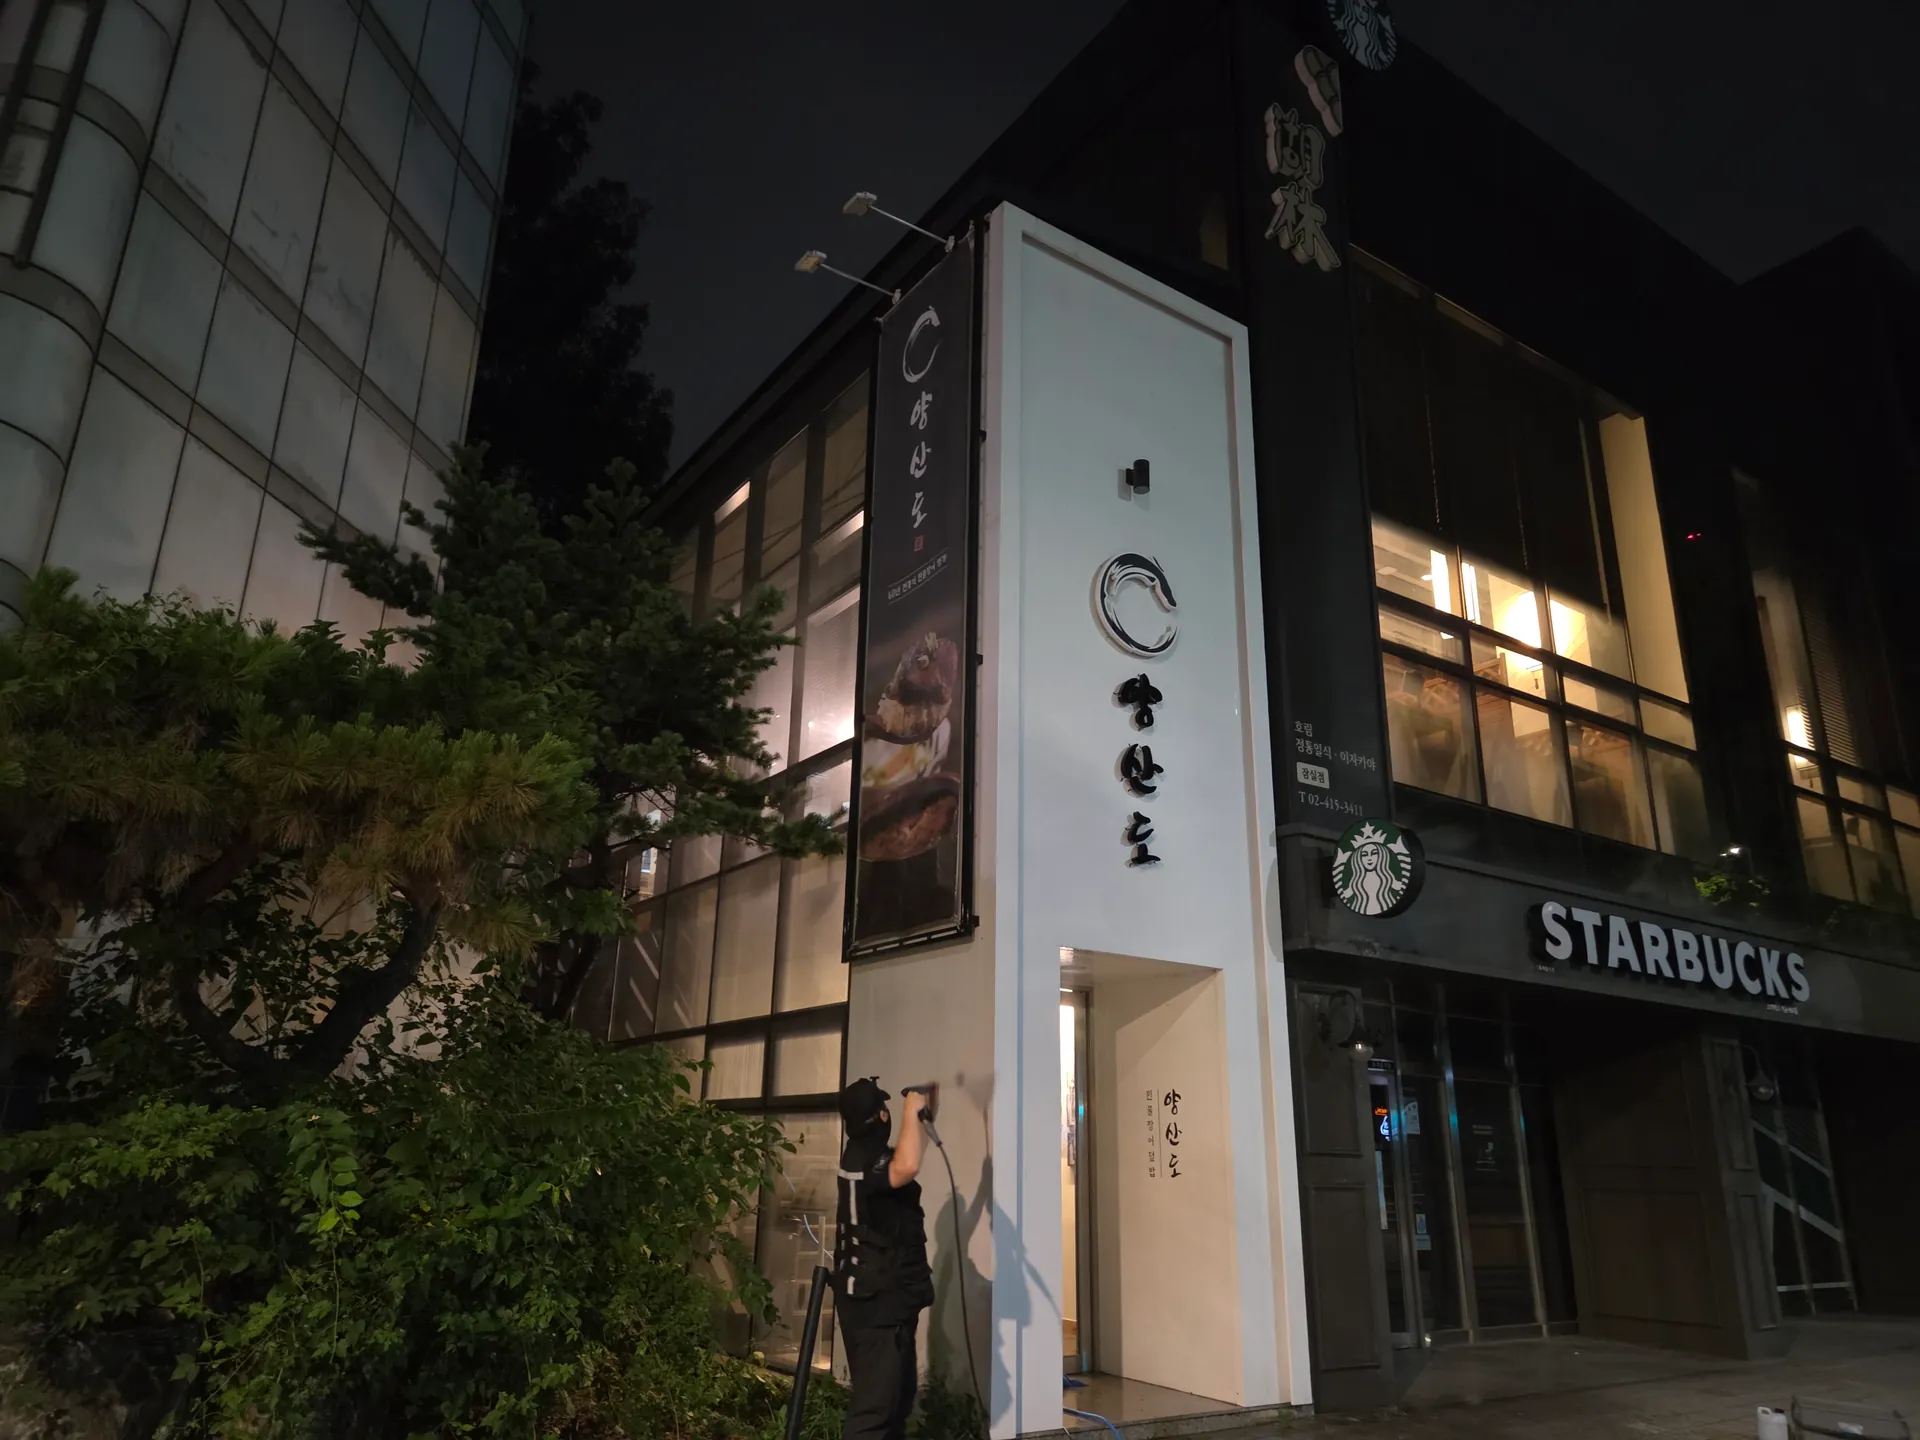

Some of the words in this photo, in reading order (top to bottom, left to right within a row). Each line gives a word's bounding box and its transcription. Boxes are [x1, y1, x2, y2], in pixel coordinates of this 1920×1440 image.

[909, 391, 933, 529] 양산도
[1294, 720, 1313, 738] 호림
[1295, 738, 1332, 760] 정통일식
[1339, 751, 1377, 772] 이자카야
[1116, 673, 1164, 866] 양산도
[1298, 791, 1306, 803] T
[1301, 767, 1326, 784] 잠실점
[1541, 901, 1811, 1002] STARBUCKS
[1163, 1088, 1182, 1178] 양산도
